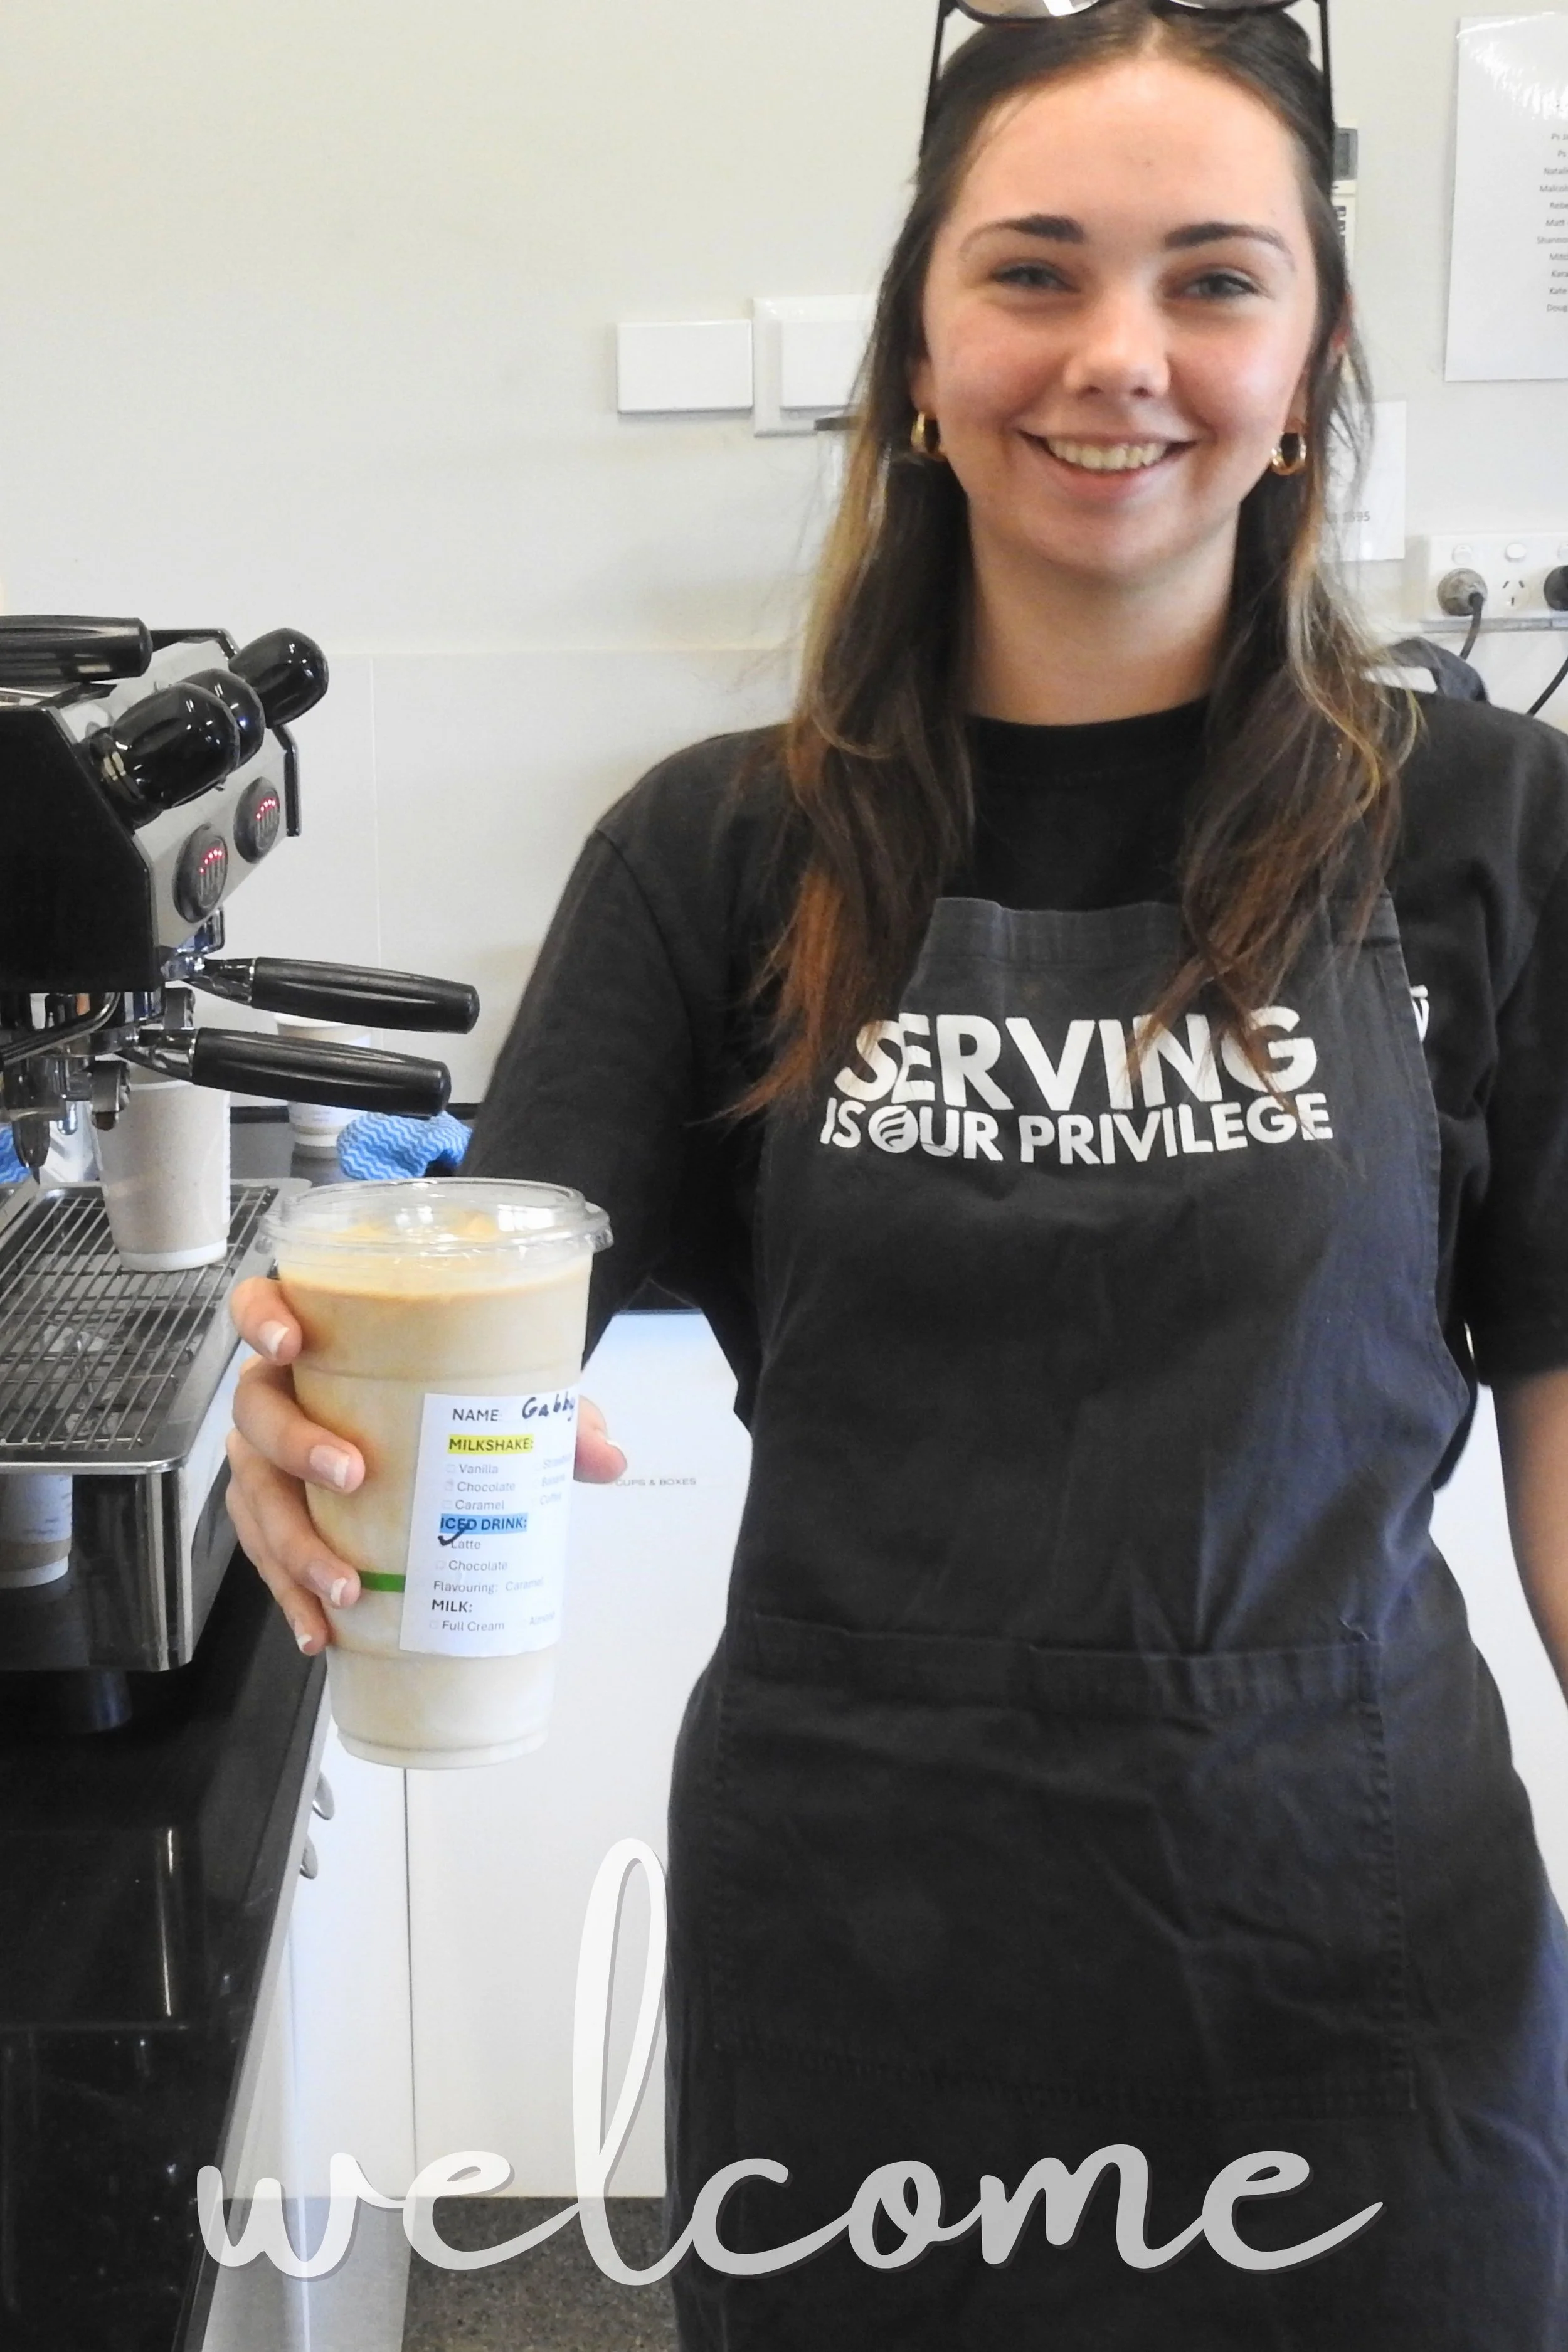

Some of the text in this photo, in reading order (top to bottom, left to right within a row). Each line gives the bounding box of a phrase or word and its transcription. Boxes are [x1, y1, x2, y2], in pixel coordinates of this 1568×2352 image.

[834, 1005, 1318, 1111] SERVING
[820, 1093, 1334, 1165] IS OUR PRIVILEGE
[448, 1438, 534, 1451] MILKSHAKE:
[459, 1463, 499, 1474] Vanilla
[457, 1481, 516, 1492] Chocolate
[455, 1500, 504, 1510] Caramel
[440, 1517, 527, 1530] ICED DRINK:
[451, 1540, 481, 1549] Latte
[448, 1560, 508, 1571] Chocolate
[433, 1581, 498, 1594] Flavouring:
[432, 1599, 473, 1613] MILK:
[442, 1621, 505, 1631] Full Cream
